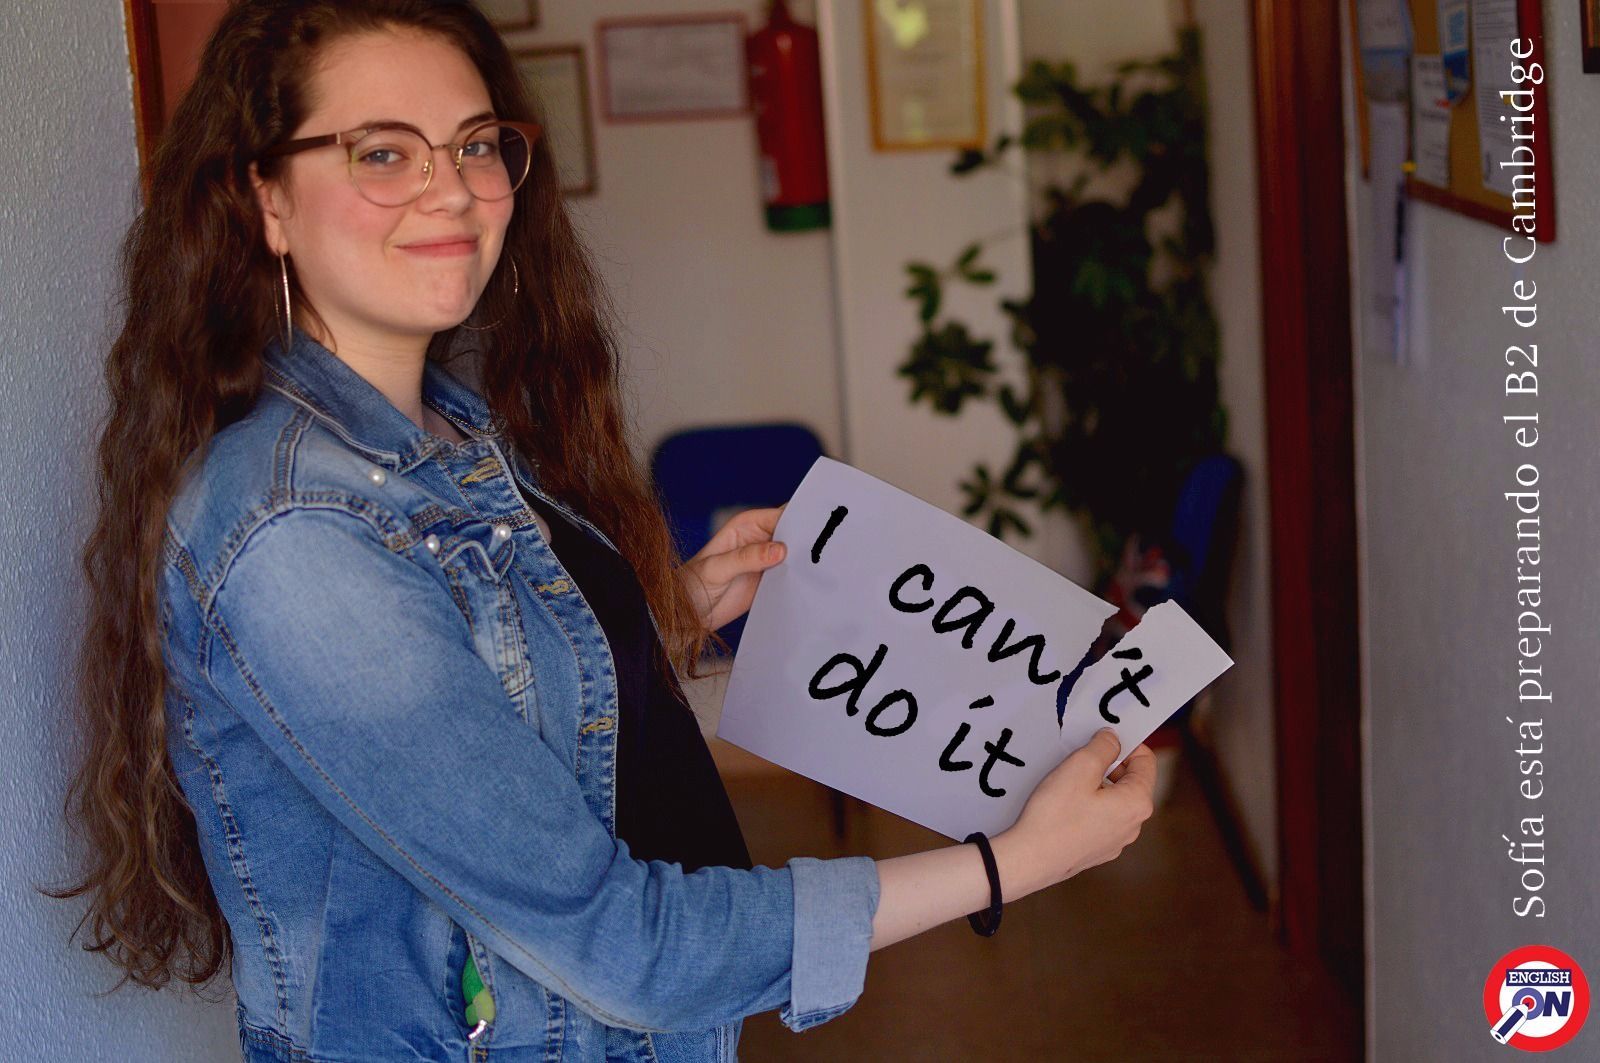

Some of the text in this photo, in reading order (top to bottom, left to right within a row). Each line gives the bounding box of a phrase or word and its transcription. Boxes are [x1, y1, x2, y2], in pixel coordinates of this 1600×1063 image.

[810, 505, 849, 564] I
[808, 643, 1026, 798] do it
